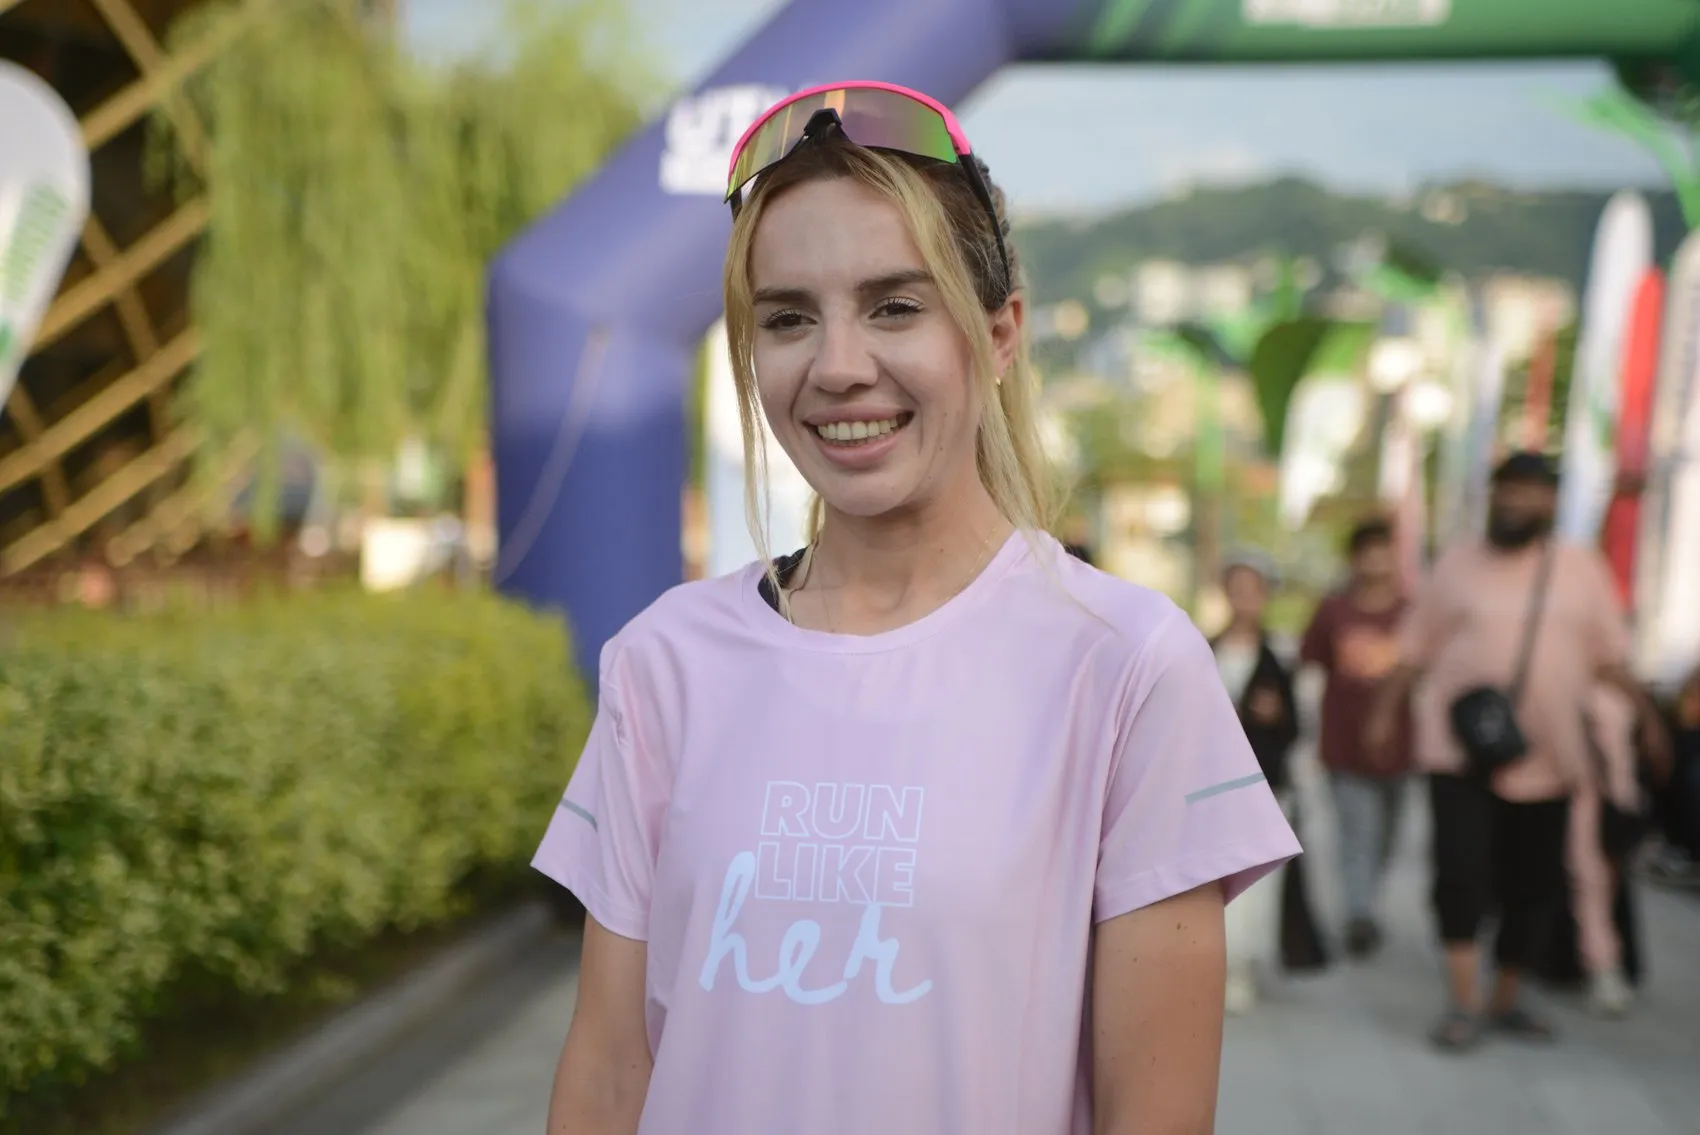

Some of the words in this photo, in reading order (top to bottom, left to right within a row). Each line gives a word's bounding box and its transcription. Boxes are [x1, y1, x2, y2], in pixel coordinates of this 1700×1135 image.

[760, 780, 924, 842] RUN
[754, 841, 917, 907] LIKE
[699, 850, 933, 1005] her
